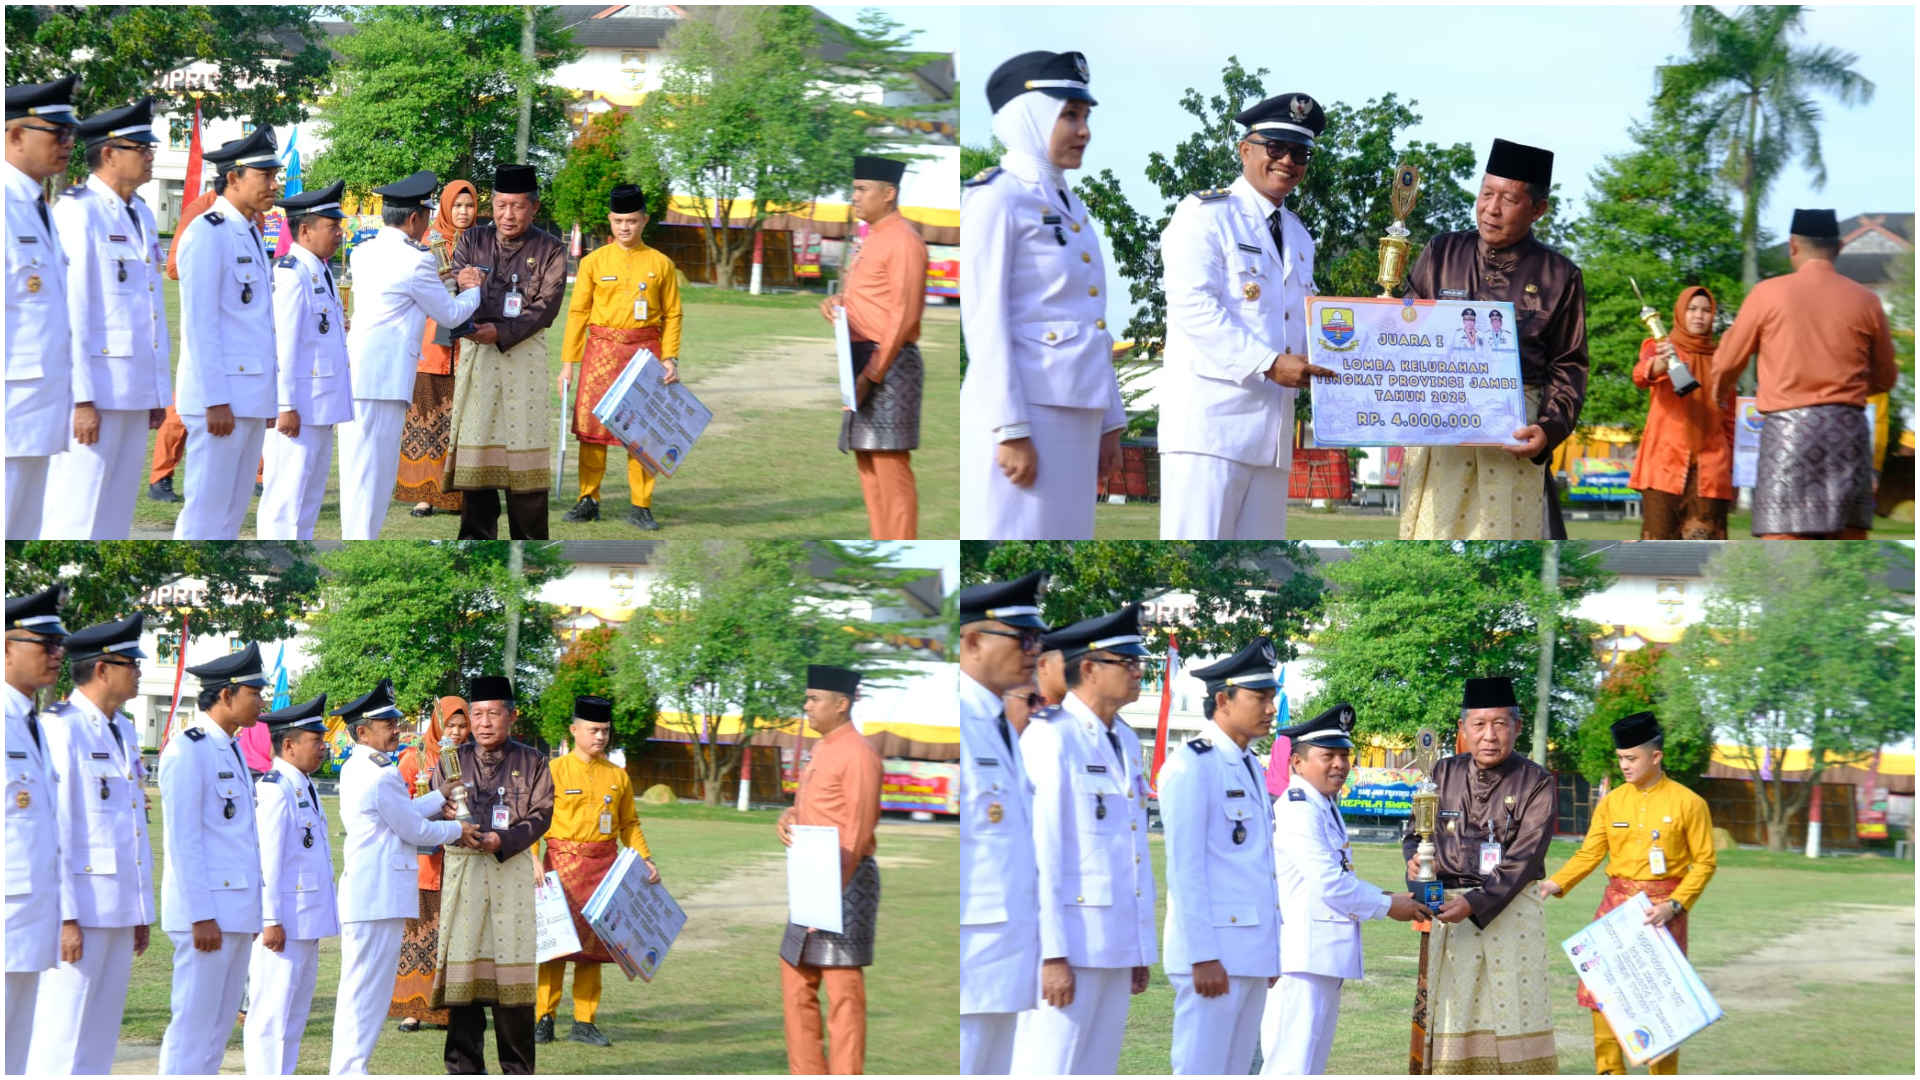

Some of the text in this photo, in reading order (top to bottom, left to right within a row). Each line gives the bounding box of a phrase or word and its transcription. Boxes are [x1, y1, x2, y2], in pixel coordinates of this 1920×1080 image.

[1377, 332, 1444, 348] JUARA I
[1342, 358, 1489, 374] LOMBA KELURAHAN
[1316, 374, 1518, 389] TINGKAT PROVINSI JAMBI
[1374, 389, 1467, 404] TAHUN 2025
[1356, 412, 1482, 428] RP. 4.000.000
